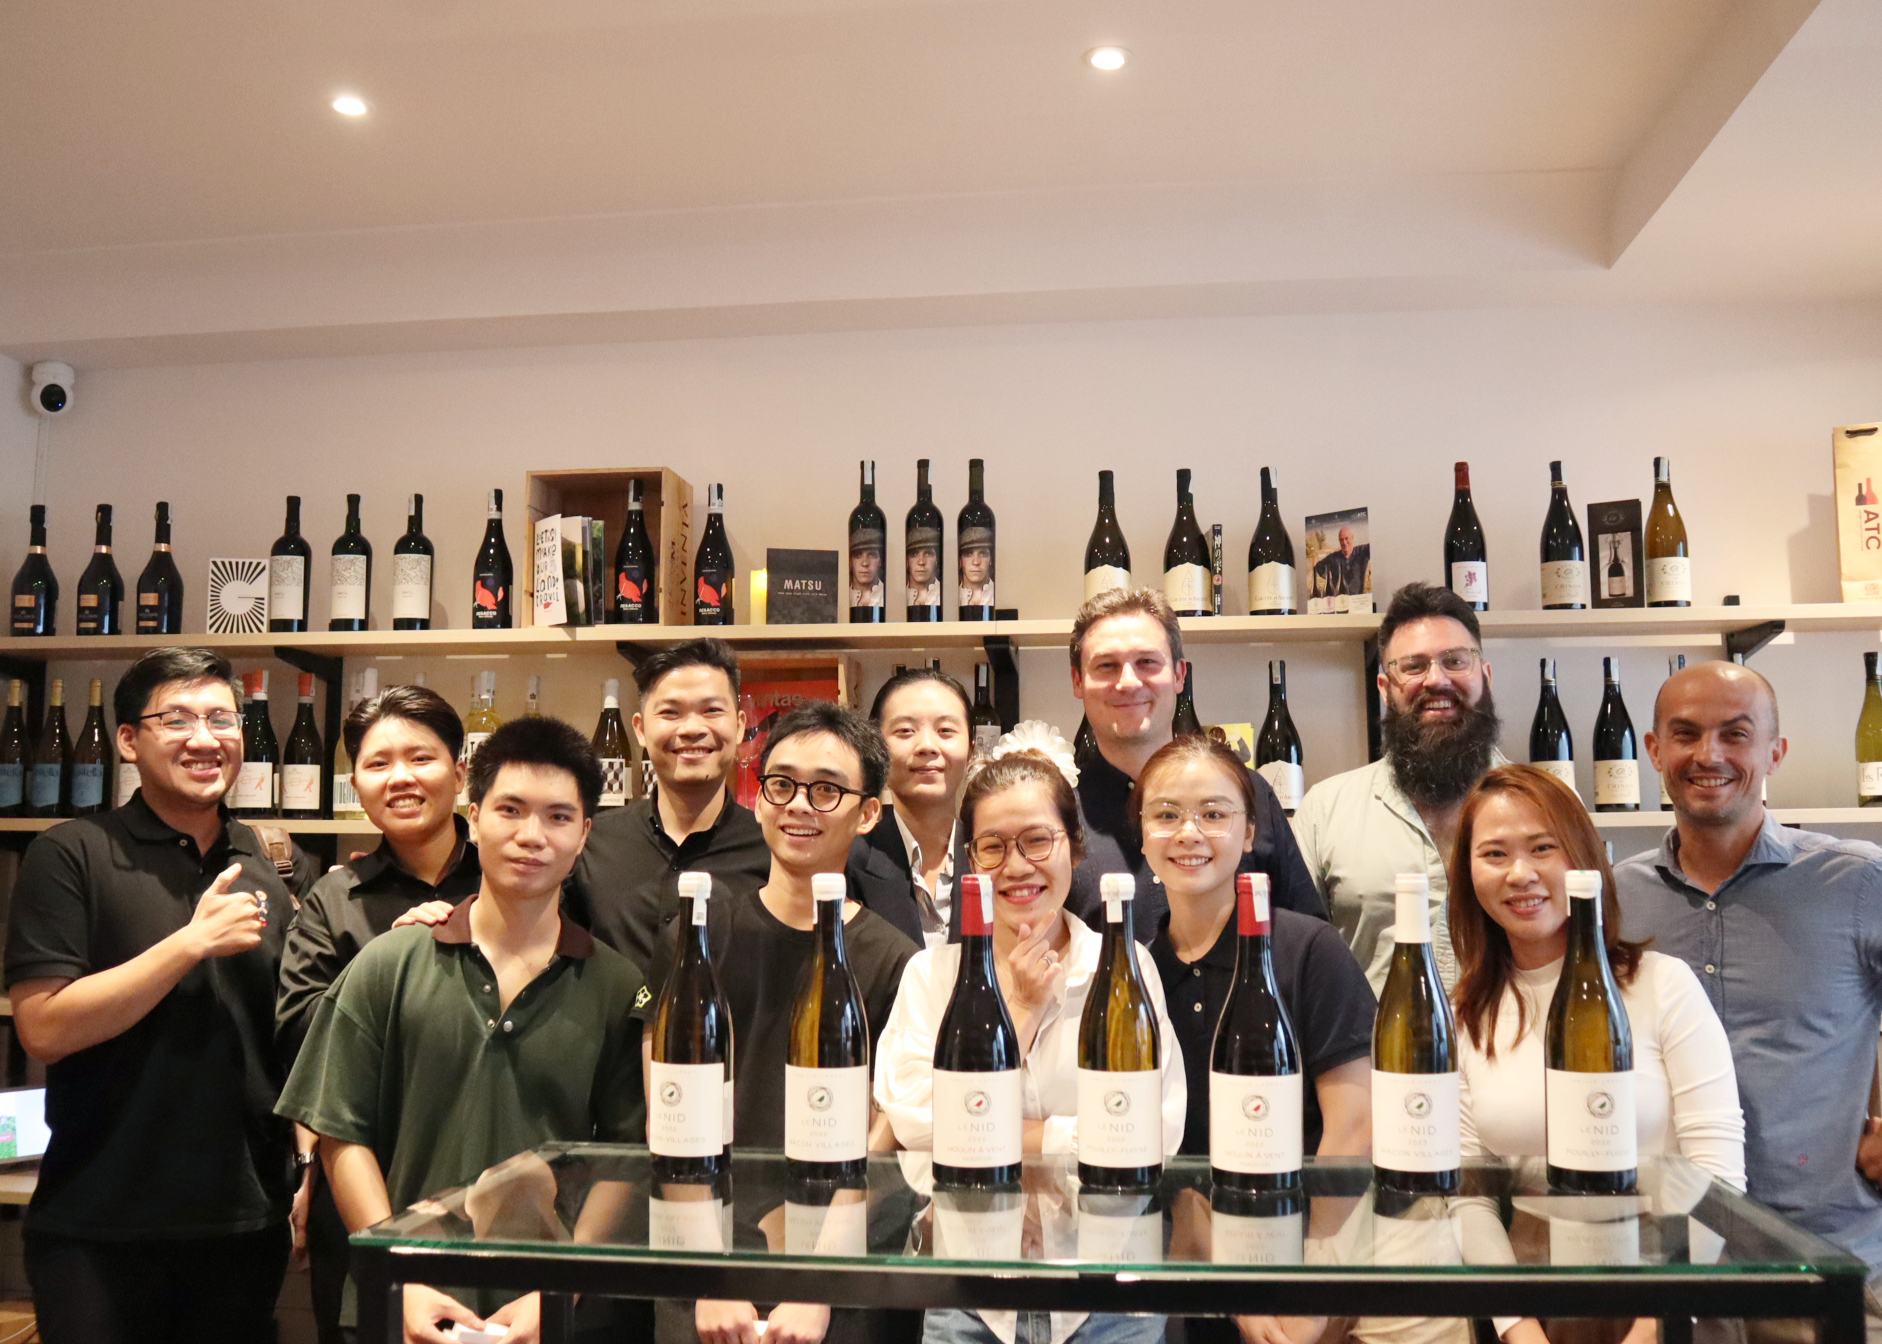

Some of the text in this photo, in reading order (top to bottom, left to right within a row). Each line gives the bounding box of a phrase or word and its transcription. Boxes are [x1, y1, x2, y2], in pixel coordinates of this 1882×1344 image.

[1863, 509, 1881, 551] ATC
[783, 579, 822, 591] MATSU
[663, 1112, 686, 1123] NID
[812, 1117, 837, 1128] NID
[970, 1122, 996, 1133] NID
[1109, 1122, 1135, 1133] NID
[1247, 1127, 1274, 1138] NID
[1410, 1125, 1437, 1136] NID
[1593, 1124, 1620, 1136] NID
[665, 1136, 706, 1144] VILLAGES
[814, 1140, 855, 1149] VILLAGES
[947, 1145, 976, 1154] MOULIN
[985, 1145, 1006, 1153] VENT
[1224, 1150, 1254, 1159] MOULIN
[1263, 1151, 1286, 1160] VENT
[1413, 1148, 1453, 1158] VILLAGES
